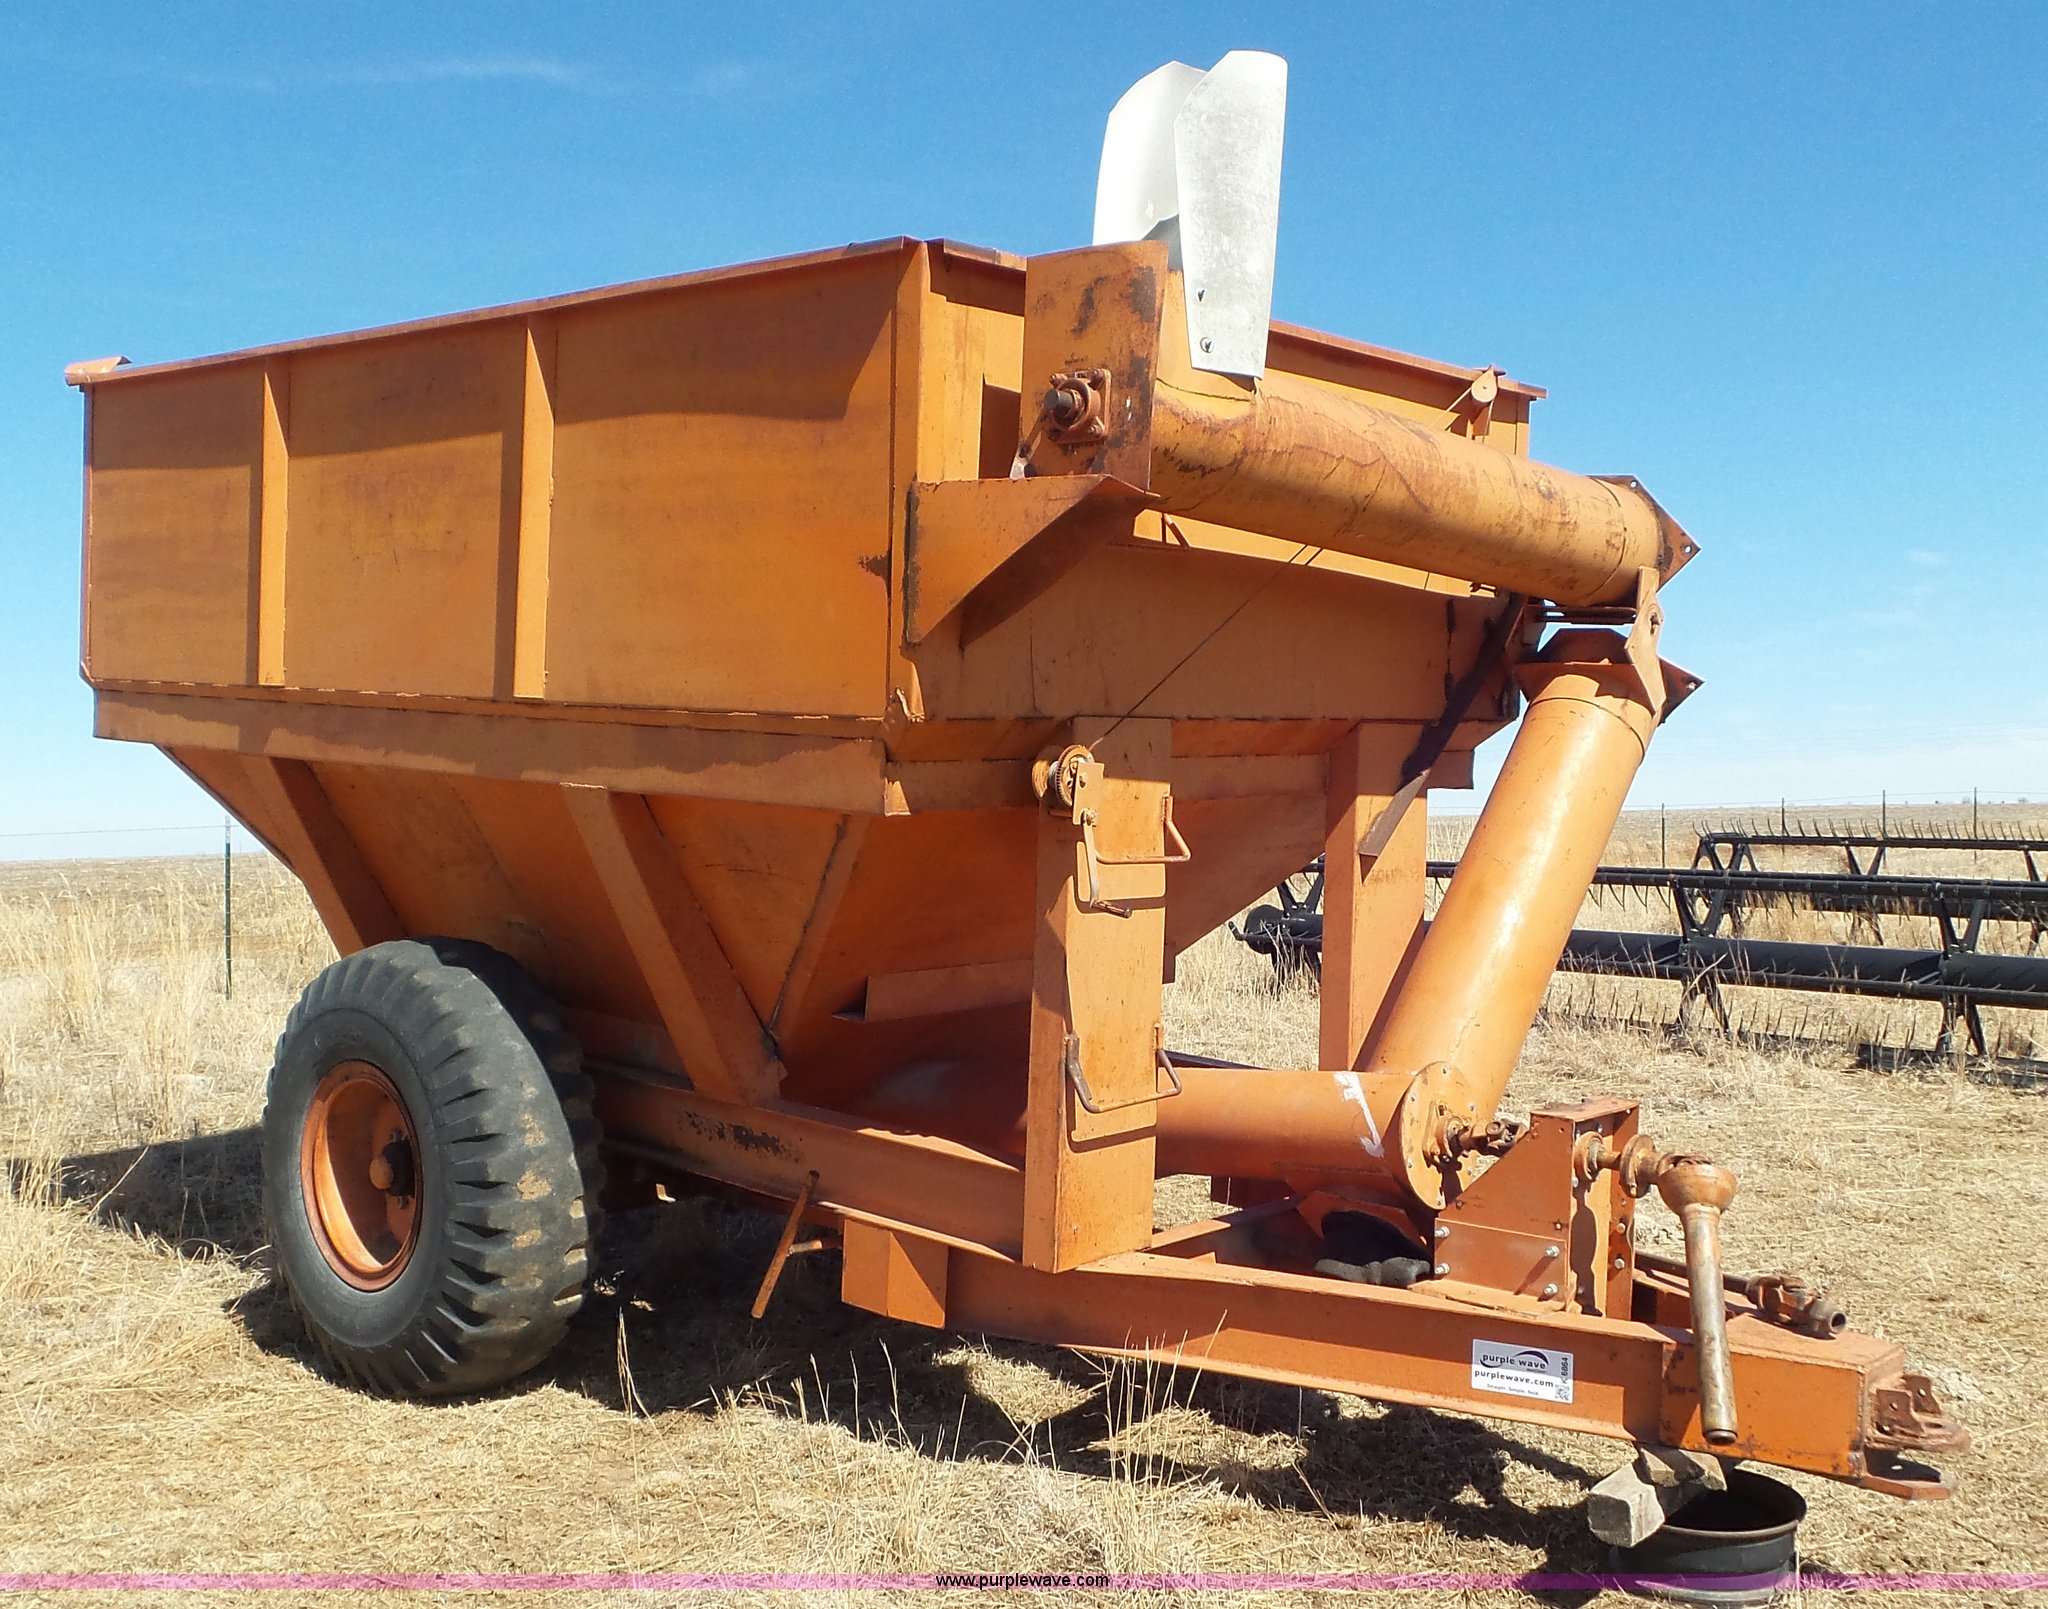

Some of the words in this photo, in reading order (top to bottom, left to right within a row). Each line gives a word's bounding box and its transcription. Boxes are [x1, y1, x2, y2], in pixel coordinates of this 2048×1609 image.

[1482, 1354, 1515, 1365] purple
[1518, 1359, 1546, 1369] wave
[1474, 1370, 1554, 1387] purplewave.com
